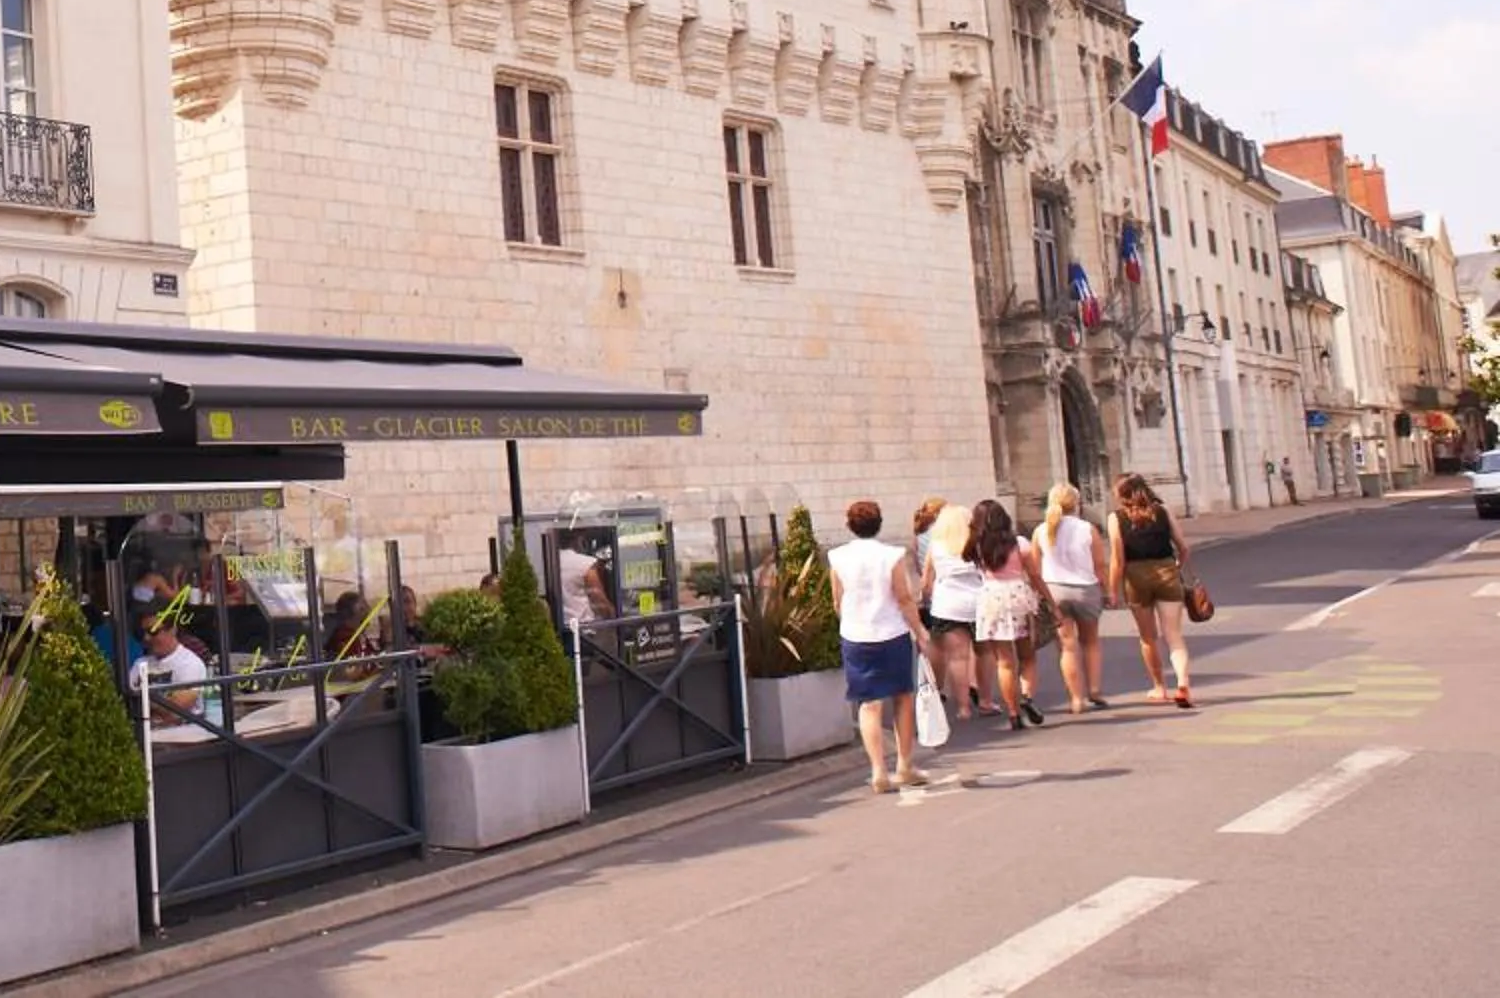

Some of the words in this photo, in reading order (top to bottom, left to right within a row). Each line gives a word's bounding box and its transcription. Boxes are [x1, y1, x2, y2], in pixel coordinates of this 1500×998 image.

[291, 417, 348, 438] BAR
[373, 416, 484, 438] GLACIER
[498, 416, 573, 436] SALON
[579, 417, 607, 434] DE
[124, 494, 157, 512] BAR
